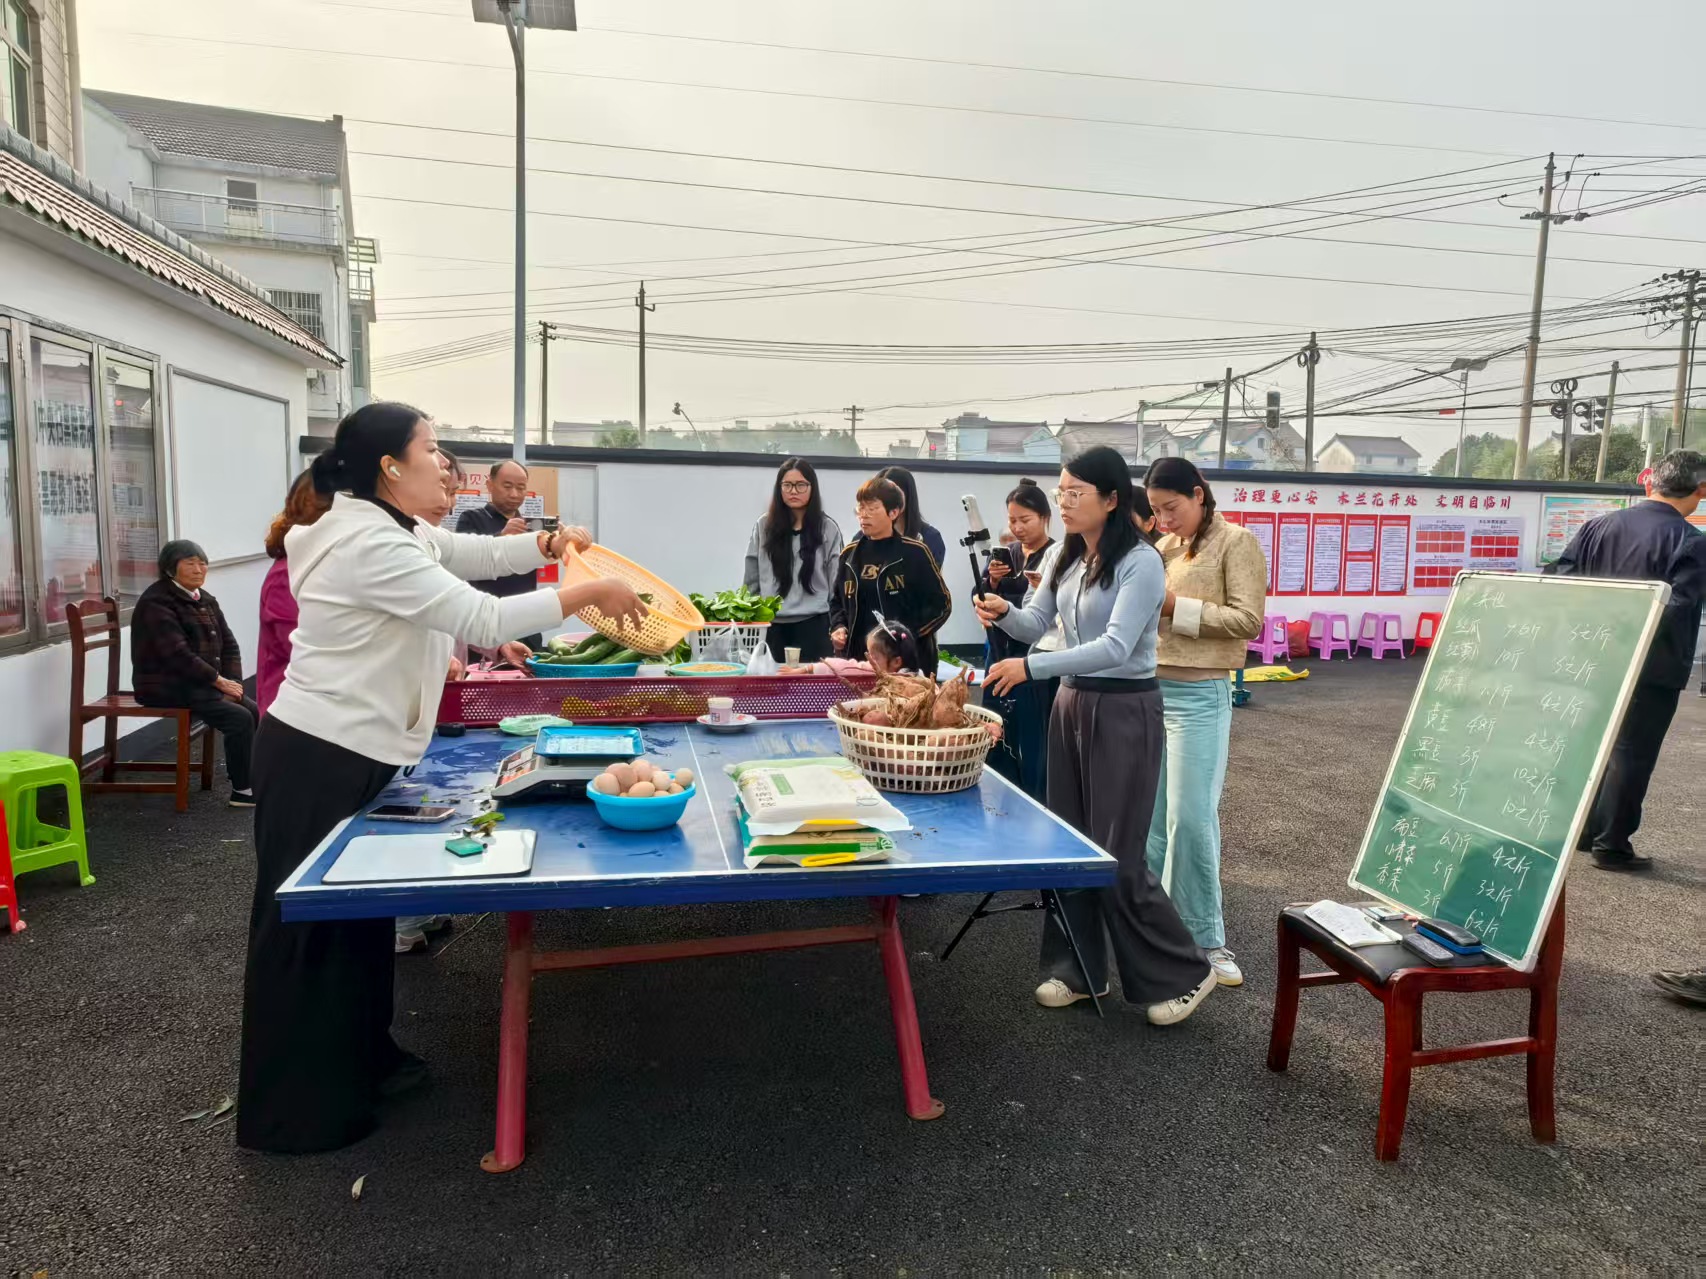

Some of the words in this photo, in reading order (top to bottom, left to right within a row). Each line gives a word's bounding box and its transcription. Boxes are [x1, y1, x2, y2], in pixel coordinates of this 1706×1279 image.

[1233, 487, 1319, 505] 治理更心安
[1337, 491, 1418, 508] 木兰花开处
[1435, 494, 1511, 510] 文明自临川
[1423, 701, 1454, 732] 黄豆
[1492, 846, 1534, 891] 4元/斤
[1376, 862, 1405, 894] 香菜
[1464, 907, 1500, 942] 6元/斤
[1477, 879, 1513, 917] 3元/斤
